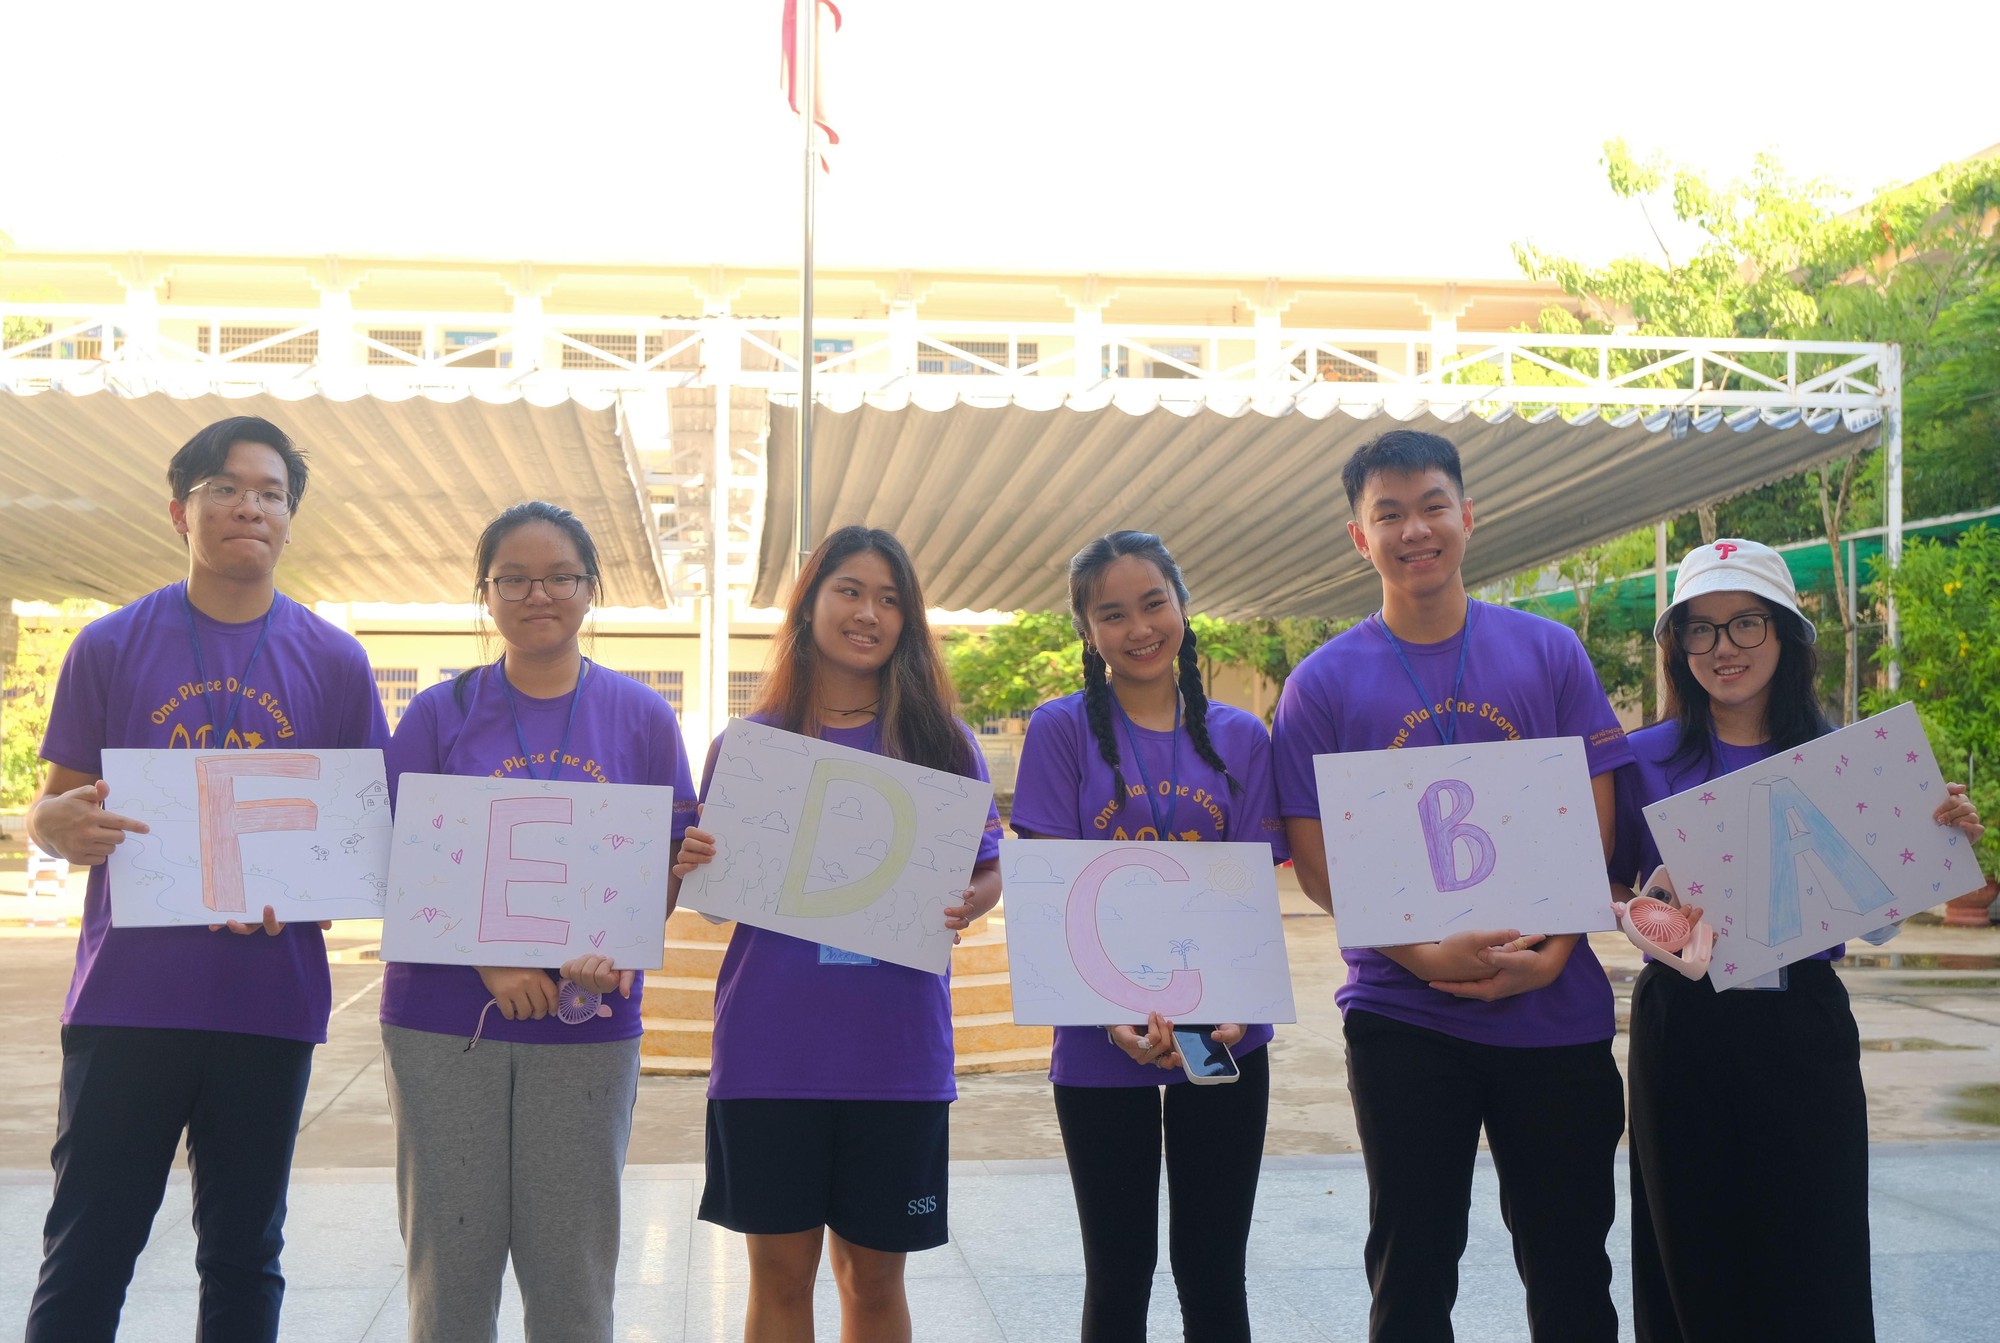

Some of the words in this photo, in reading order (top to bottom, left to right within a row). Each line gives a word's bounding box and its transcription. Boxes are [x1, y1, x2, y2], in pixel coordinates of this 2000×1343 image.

[1714, 543, 1738, 560] P
[151, 697, 180, 725] One
[177, 680, 222, 701] Place
[258, 692, 295, 739] Story
[1403, 703, 1444, 729] Plae
[1479, 702, 1521, 741] Story
[502, 753, 545, 773] Place
[582, 759, 608, 784] Sto
[195, 753, 320, 913] F
[774, 758, 917, 918] D
[1094, 799, 1119, 830] One
[1418, 779, 1496, 893] B
[478, 796, 573, 945] E
[1746, 775, 1898, 947] A
[1065, 847, 1203, 1016] C
[907, 1195, 937, 1215] SSIS
